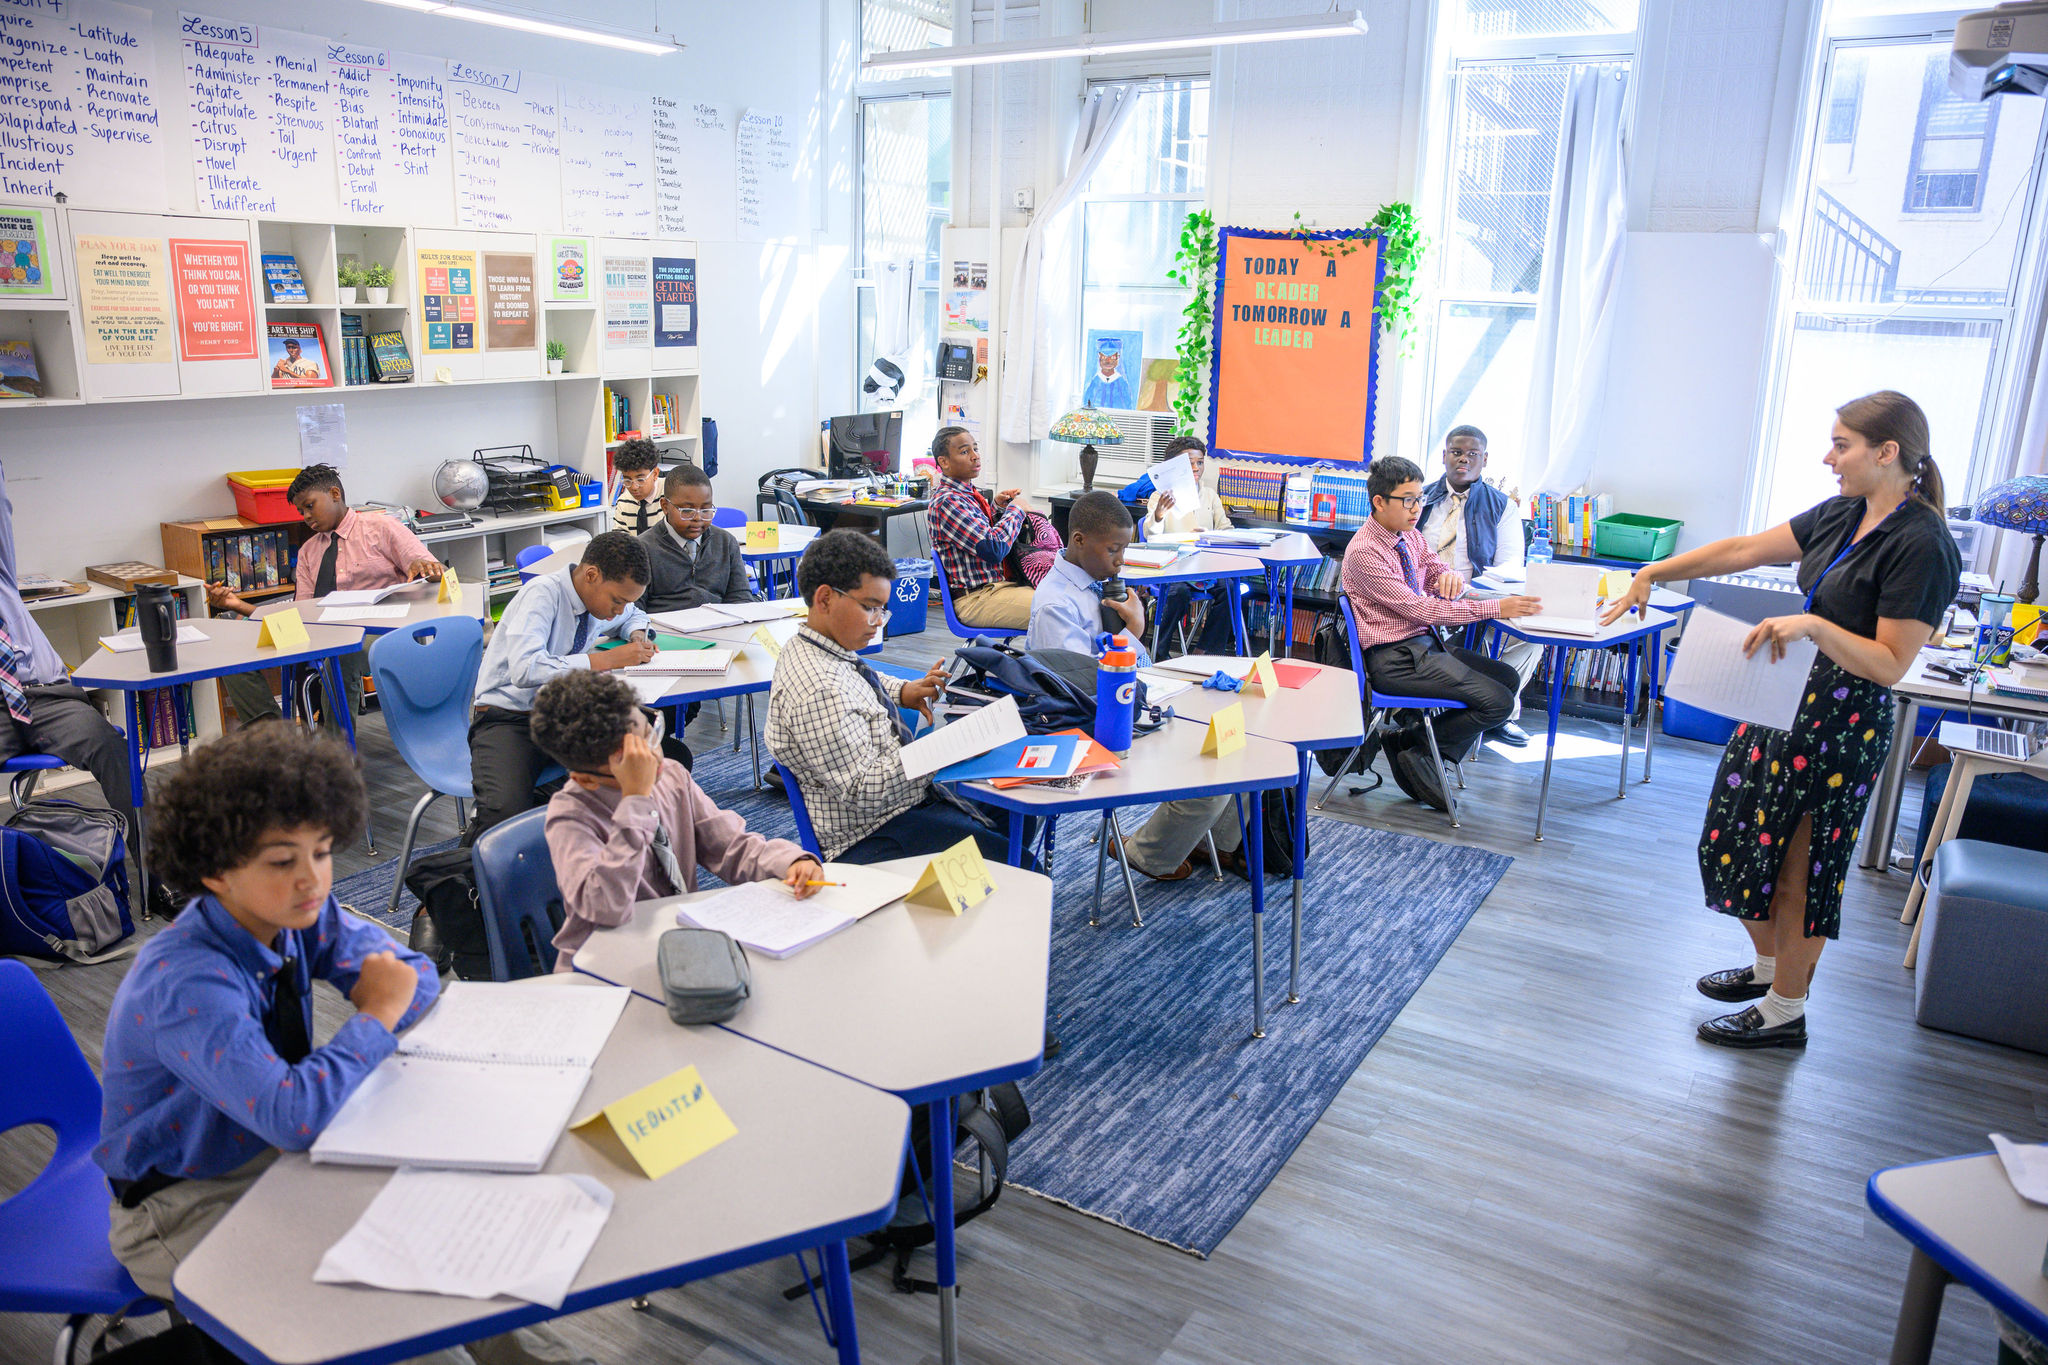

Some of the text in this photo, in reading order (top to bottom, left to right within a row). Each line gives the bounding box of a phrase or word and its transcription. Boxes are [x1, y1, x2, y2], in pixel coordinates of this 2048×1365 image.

[78, 23, 139, 48] Latitude
[182, 16, 252, 44] Lesson 5
[84, 48, 124, 66] Loath
[194, 41, 256, 68] Adequate
[327, 44, 385, 66] Lesson 6
[275, 55, 317, 73] Menial
[86, 67, 148, 89] Maintain
[195, 64, 261, 87] Administer
[273, 72, 329, 94] Permanent
[338, 67, 371, 83] Addict
[452, 63, 510, 88] Lesson 7
[86, 83, 151, 106] Renovate
[196, 83, 244, 103] Agitate
[339, 82, 370, 99] Aspire
[396, 73, 443, 100] Impunity
[197, 101, 258, 120] Capitulate
[274, 93, 318, 113] Respite
[340, 98, 365, 114] Bias
[397, 91, 446, 119] Intensity
[87, 102, 159, 127] Reprimand
[275, 113, 324, 131] Strenuous
[342, 115, 379, 130] Blatant
[398, 109, 449, 128] Intimidate
[91, 124, 153, 144] Supervise
[200, 120, 238, 136] Citrus
[277, 129, 295, 145] Toil
[399, 127, 446, 144] Obnoxious
[202, 137, 247, 156] Disrupt
[344, 132, 377, 146] Candid
[278, 148, 318, 169] Urgent
[346, 148, 382, 160] Confront
[400, 143, 436, 158] Retort
[0, 152, 65, 175] Incident
[205, 156, 236, 171] Hovel
[348, 163, 375, 177] Debut
[403, 161, 429, 176] Stint
[2, 177, 54, 197] Inherit
[208, 174, 262, 191] Illiterate
[350, 180, 378, 194] Enroll
[210, 194, 276, 213] Indifferent
[351, 198, 384, 214] Fluster
[80, 239, 107, 250] PLAN
[110, 240, 137, 252] YOUR
[184, 253, 238, 266] WHETHER YOU
[1244, 257, 1337, 278] TODAY A
[93, 268, 103, 276] EAT
[104, 269, 119, 277] WELL
[183, 269, 209, 280] THINK
[209, 269, 224, 280] YOU
[488, 275, 506, 283] THOSE
[519, 276, 531, 284] FAIL
[95, 278, 110, 286] YOUR
[110, 279, 124, 287] MIND
[124, 279, 136, 287] AND
[188, 284, 240, 295] OR YOU THINK
[655, 281, 695, 292] GETTING
[1255, 281, 1320, 302] READER
[196, 298, 235, 309] YOU CAN'T
[655, 292, 695, 302] STARTED
[1232, 304, 1351, 329] TOMORROW A
[192, 321, 220, 332] YOU'RE
[271, 326, 315, 335] ARE THE SHIP
[1254, 327, 1314, 350] LEADER
